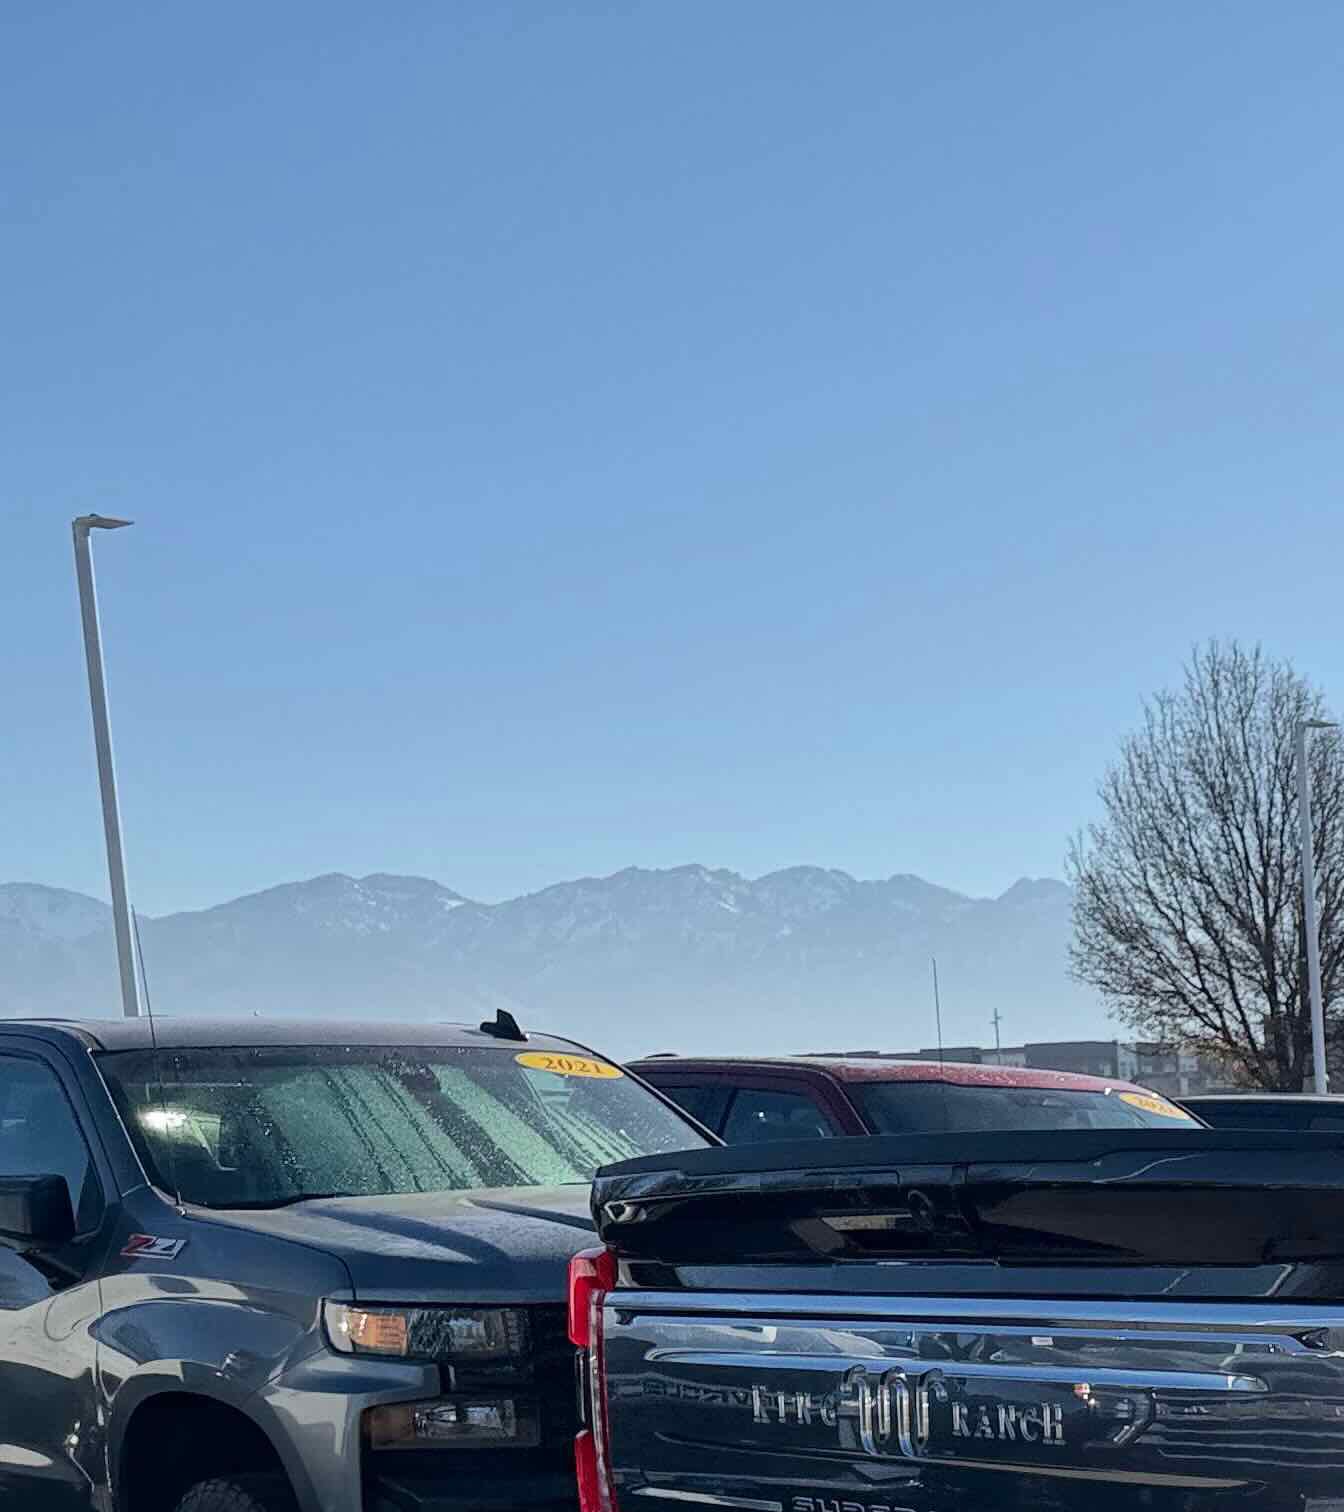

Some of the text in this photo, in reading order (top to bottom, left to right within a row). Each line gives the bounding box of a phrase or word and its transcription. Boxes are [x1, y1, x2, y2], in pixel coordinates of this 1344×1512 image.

[543, 1057, 601, 1074] 2021
[752, 1384, 1067, 1445] KING RANCH
